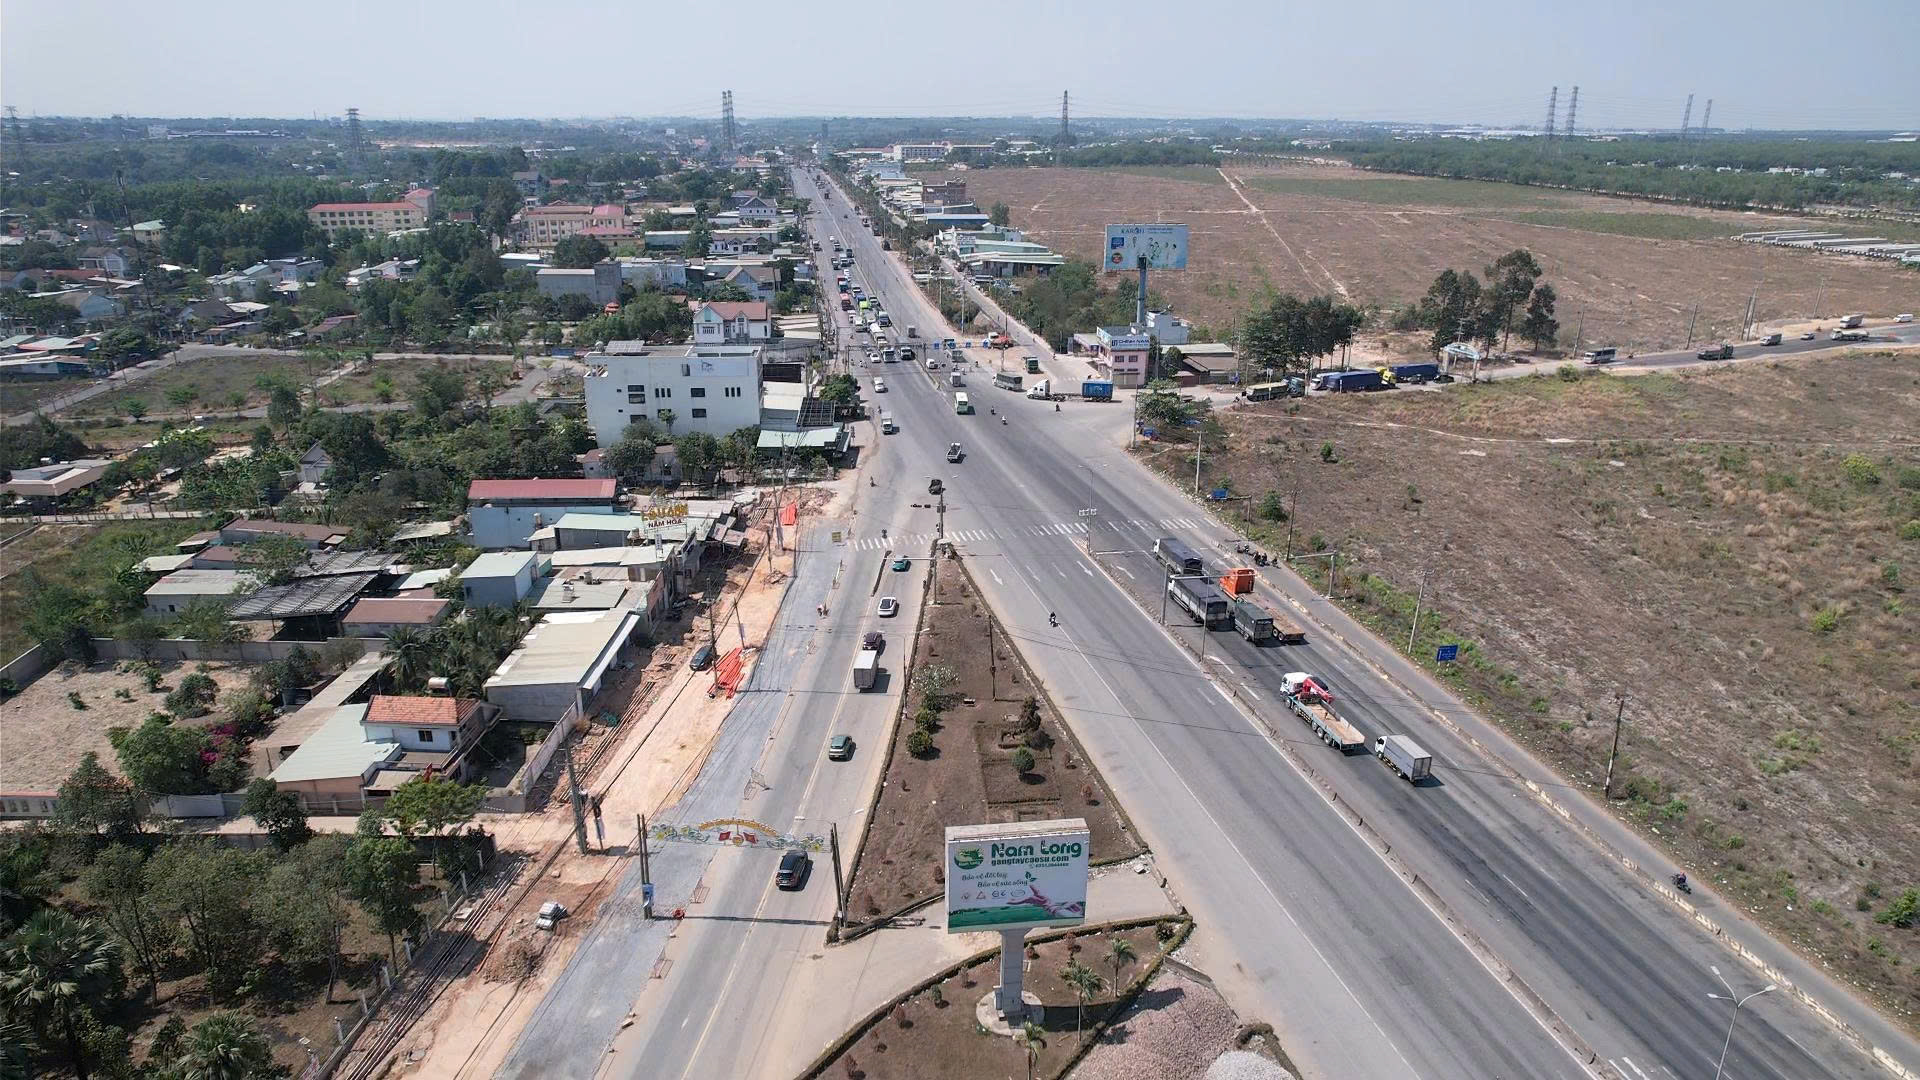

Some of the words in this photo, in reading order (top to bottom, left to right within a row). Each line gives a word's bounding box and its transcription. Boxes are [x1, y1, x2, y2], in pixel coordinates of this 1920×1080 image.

[991, 842, 1034, 859] Nam
[1040, 840, 1082, 857] Long
[991, 855, 1069, 866] gangtaycaosu.com
